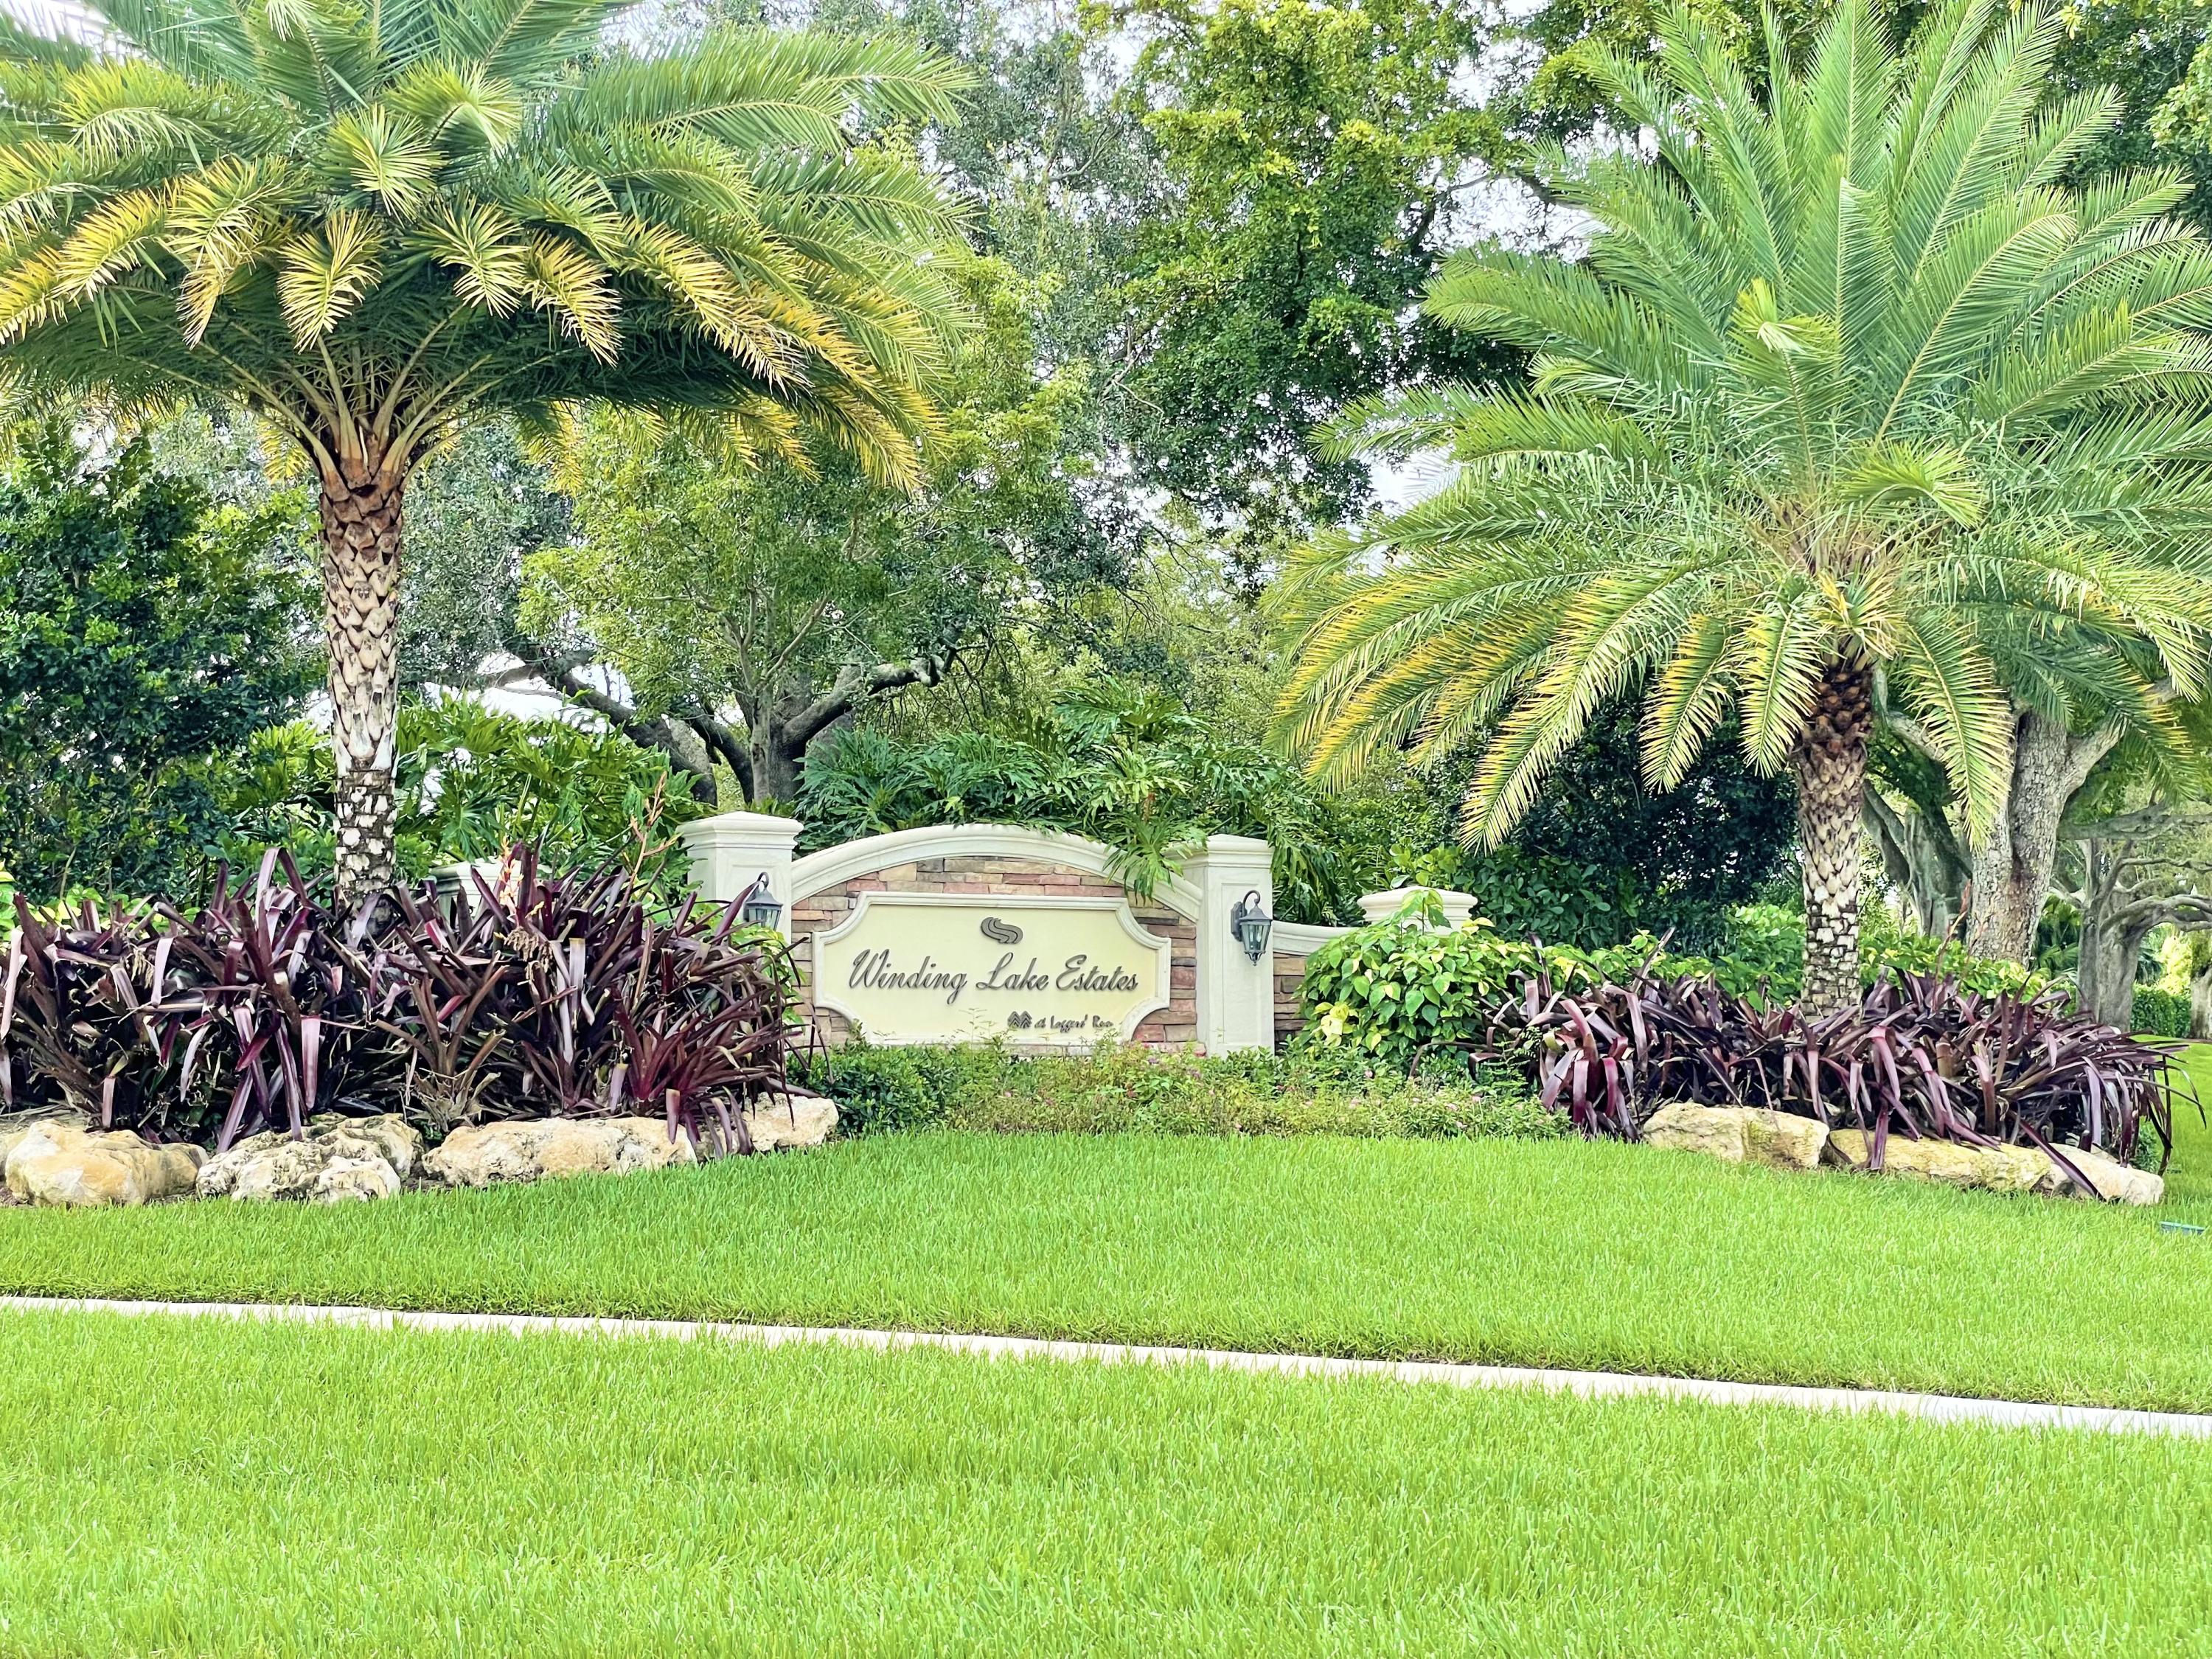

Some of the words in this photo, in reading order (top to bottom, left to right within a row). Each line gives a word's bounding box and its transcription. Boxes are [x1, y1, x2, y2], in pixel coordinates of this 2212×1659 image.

[849, 948, 967, 1004] Winding
[975, 952, 1049, 991] Lake
[1055, 954, 1138, 991] Estates
